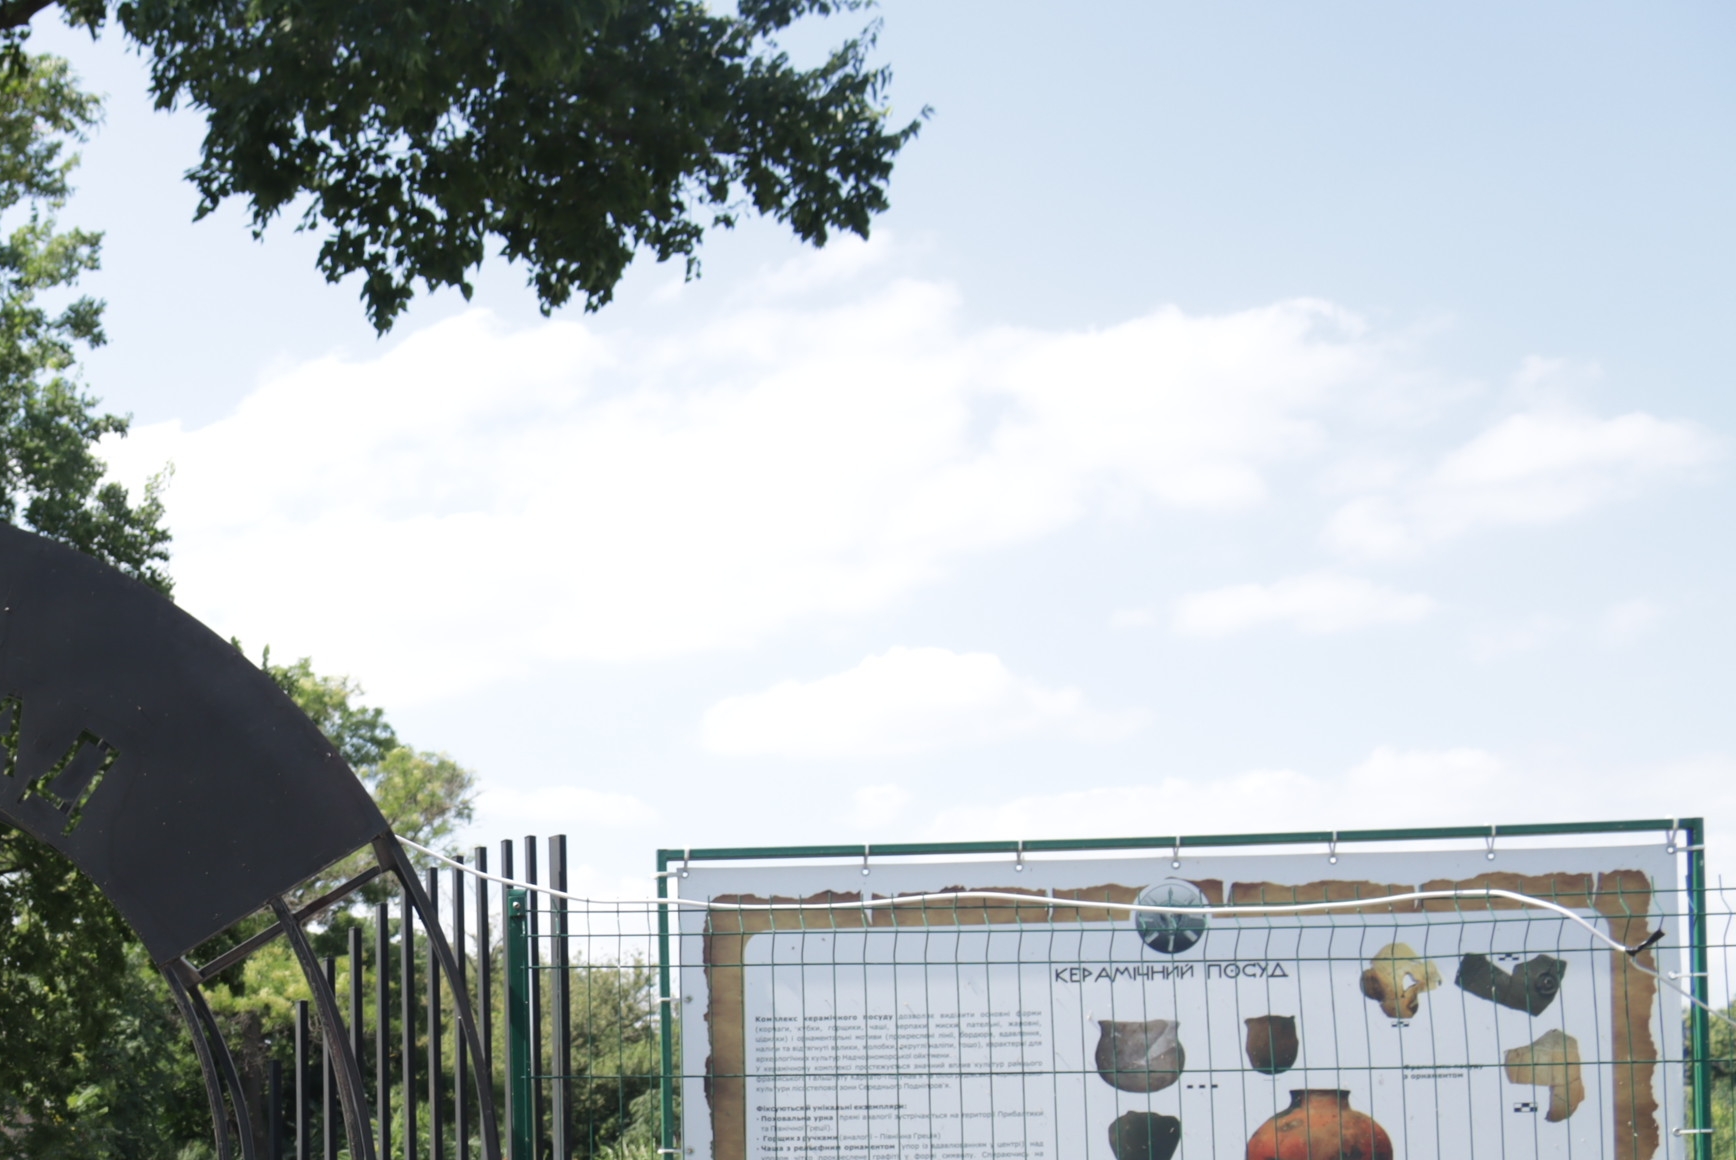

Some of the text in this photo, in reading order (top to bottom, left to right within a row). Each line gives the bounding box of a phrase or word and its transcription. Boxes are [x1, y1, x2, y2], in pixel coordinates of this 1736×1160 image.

[1055, 962, 1289, 983] КЕРАМІЧНИЙ ПОСУД
[813, 1104, 852, 1112] унікаьні
